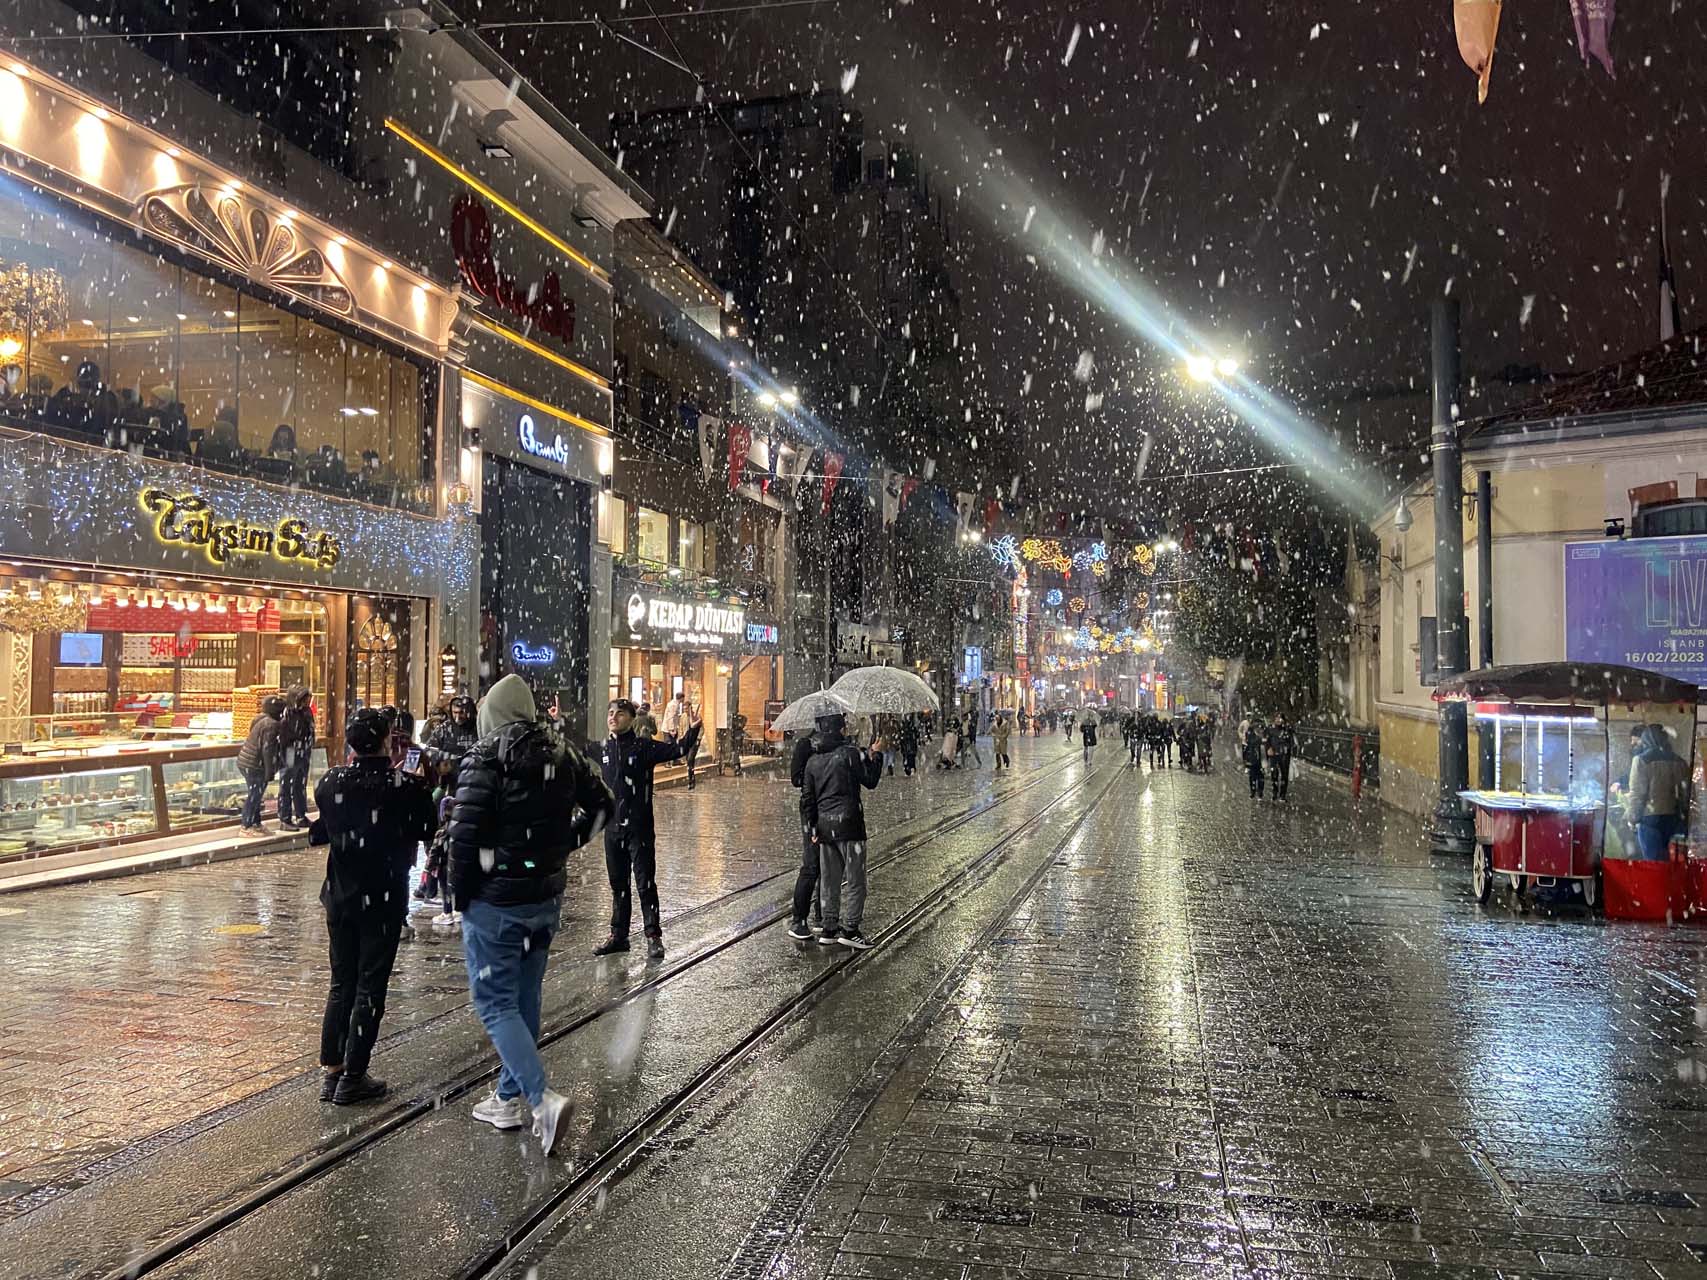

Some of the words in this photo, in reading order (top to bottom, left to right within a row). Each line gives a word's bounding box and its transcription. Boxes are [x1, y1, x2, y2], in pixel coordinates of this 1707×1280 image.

[519, 414, 569, 464] Bambi
[140, 488, 275, 564] Taksim
[648, 599, 694, 630] KEBAP
[694, 602, 744, 634] DÜNYASI
[512, 644, 554, 661] Bambi
[1625, 651, 1705, 663] 16/02/2023
